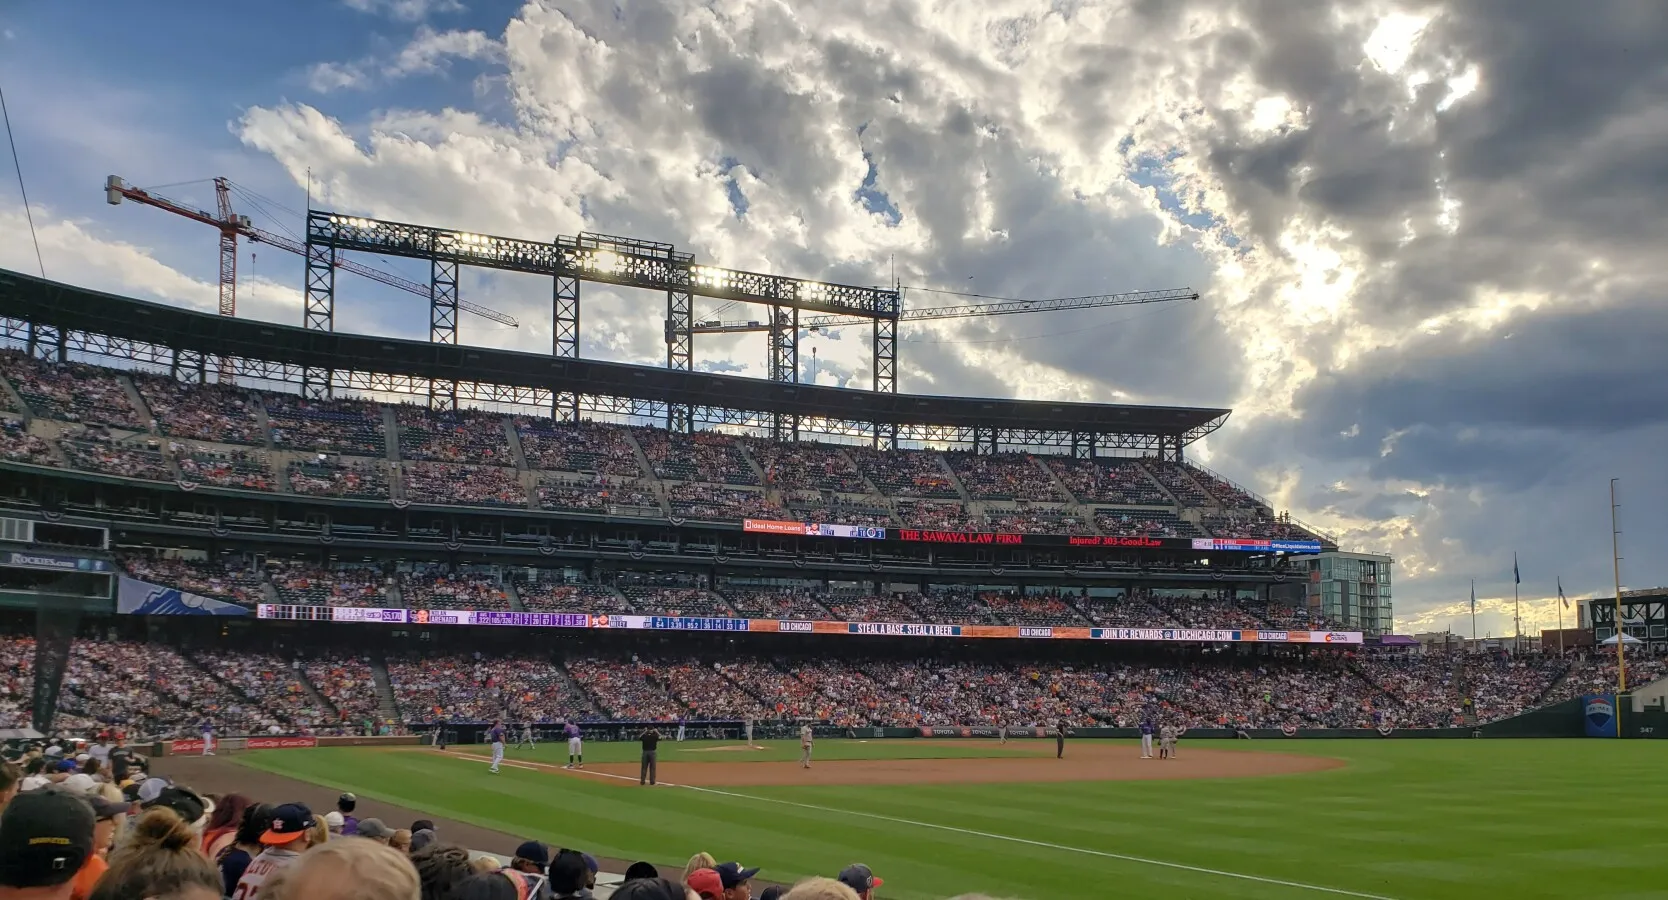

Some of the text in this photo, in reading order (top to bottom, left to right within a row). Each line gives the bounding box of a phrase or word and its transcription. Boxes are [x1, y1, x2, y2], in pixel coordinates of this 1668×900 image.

[752, 522, 801, 533] Ideal Home Loans
[899, 530, 1022, 544] THE SAWAYA LAW FIRM
[1070, 536, 1162, 546] Injured? 303-Good-Law
[780, 621, 812, 631] OLD CHICAGO
[857, 624, 879, 633] STEAL
[880, 625, 886, 634] A
[907, 626, 929, 635] STEAL
[929, 627, 935, 635] A
[935, 627, 953, 635] BEER
[1020, 628, 1052, 637] OLD CHICAGO
[1100, 629, 1117, 639] JOIN
[1130, 629, 1163, 639] REWARDS
[1164, 630, 1172, 639] @
[1172, 630, 1233, 641] OLDCHICAGO.COM
[1258, 632, 1287, 641] OLD CHICAGO
